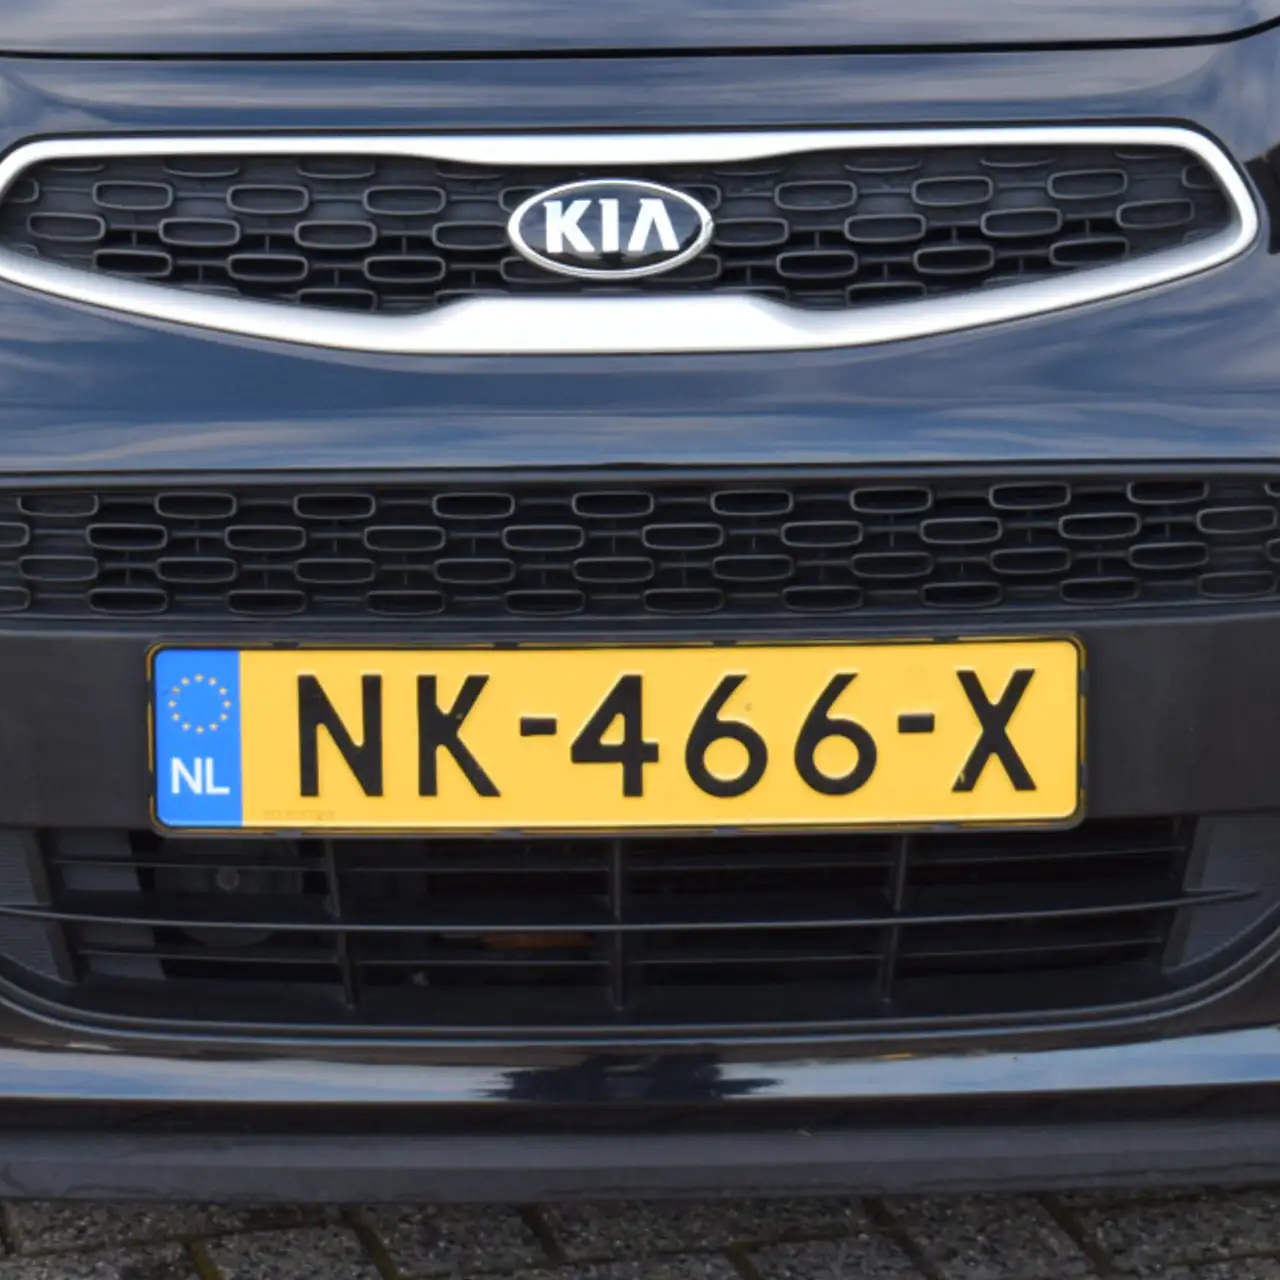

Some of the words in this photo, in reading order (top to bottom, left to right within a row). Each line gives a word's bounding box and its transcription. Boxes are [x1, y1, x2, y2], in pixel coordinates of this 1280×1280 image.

[543, 198, 680, 253] KIA
[297, 669, 1037, 798] NK-466-X
[170, 757, 231, 795] NL
